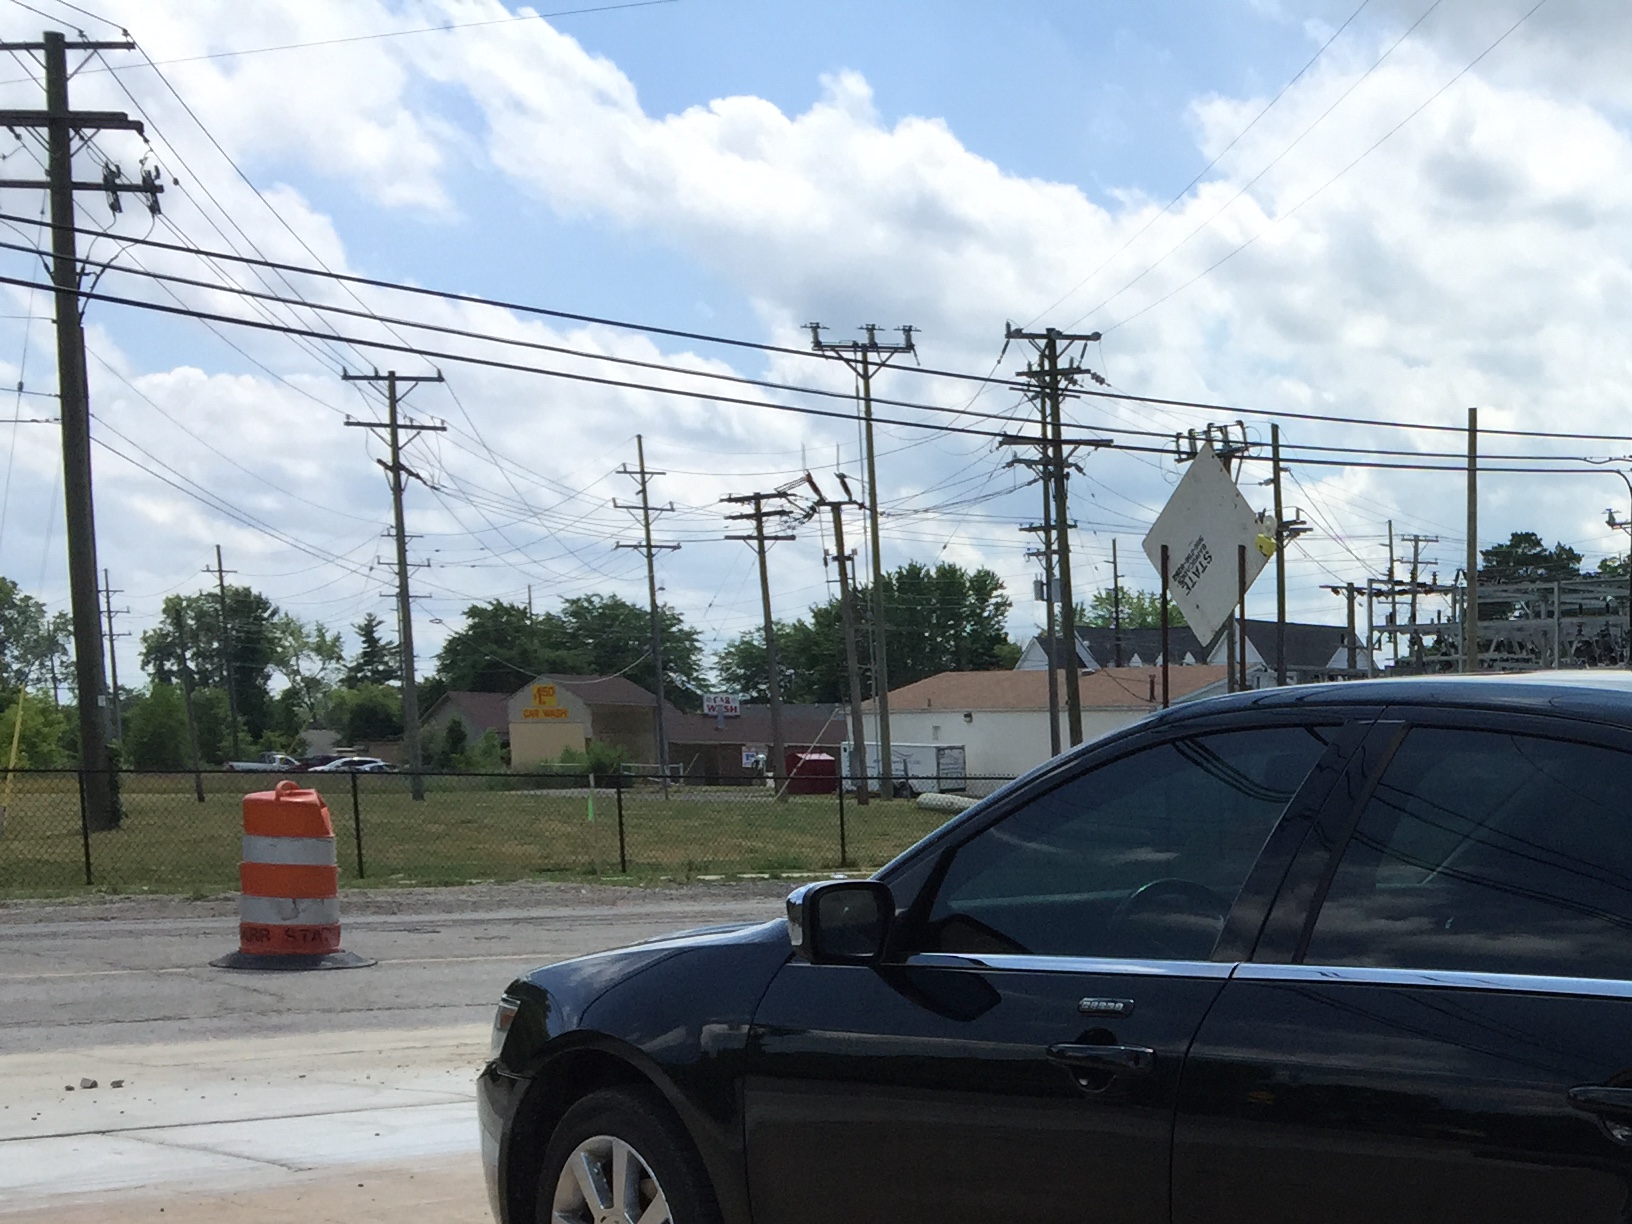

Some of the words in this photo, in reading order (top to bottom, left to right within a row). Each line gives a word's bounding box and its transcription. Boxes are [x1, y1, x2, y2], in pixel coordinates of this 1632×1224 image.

[1186, 551, 1212, 597] STATE
[523, 709, 539, 718] CAR
[543, 709, 567, 718] WASH
